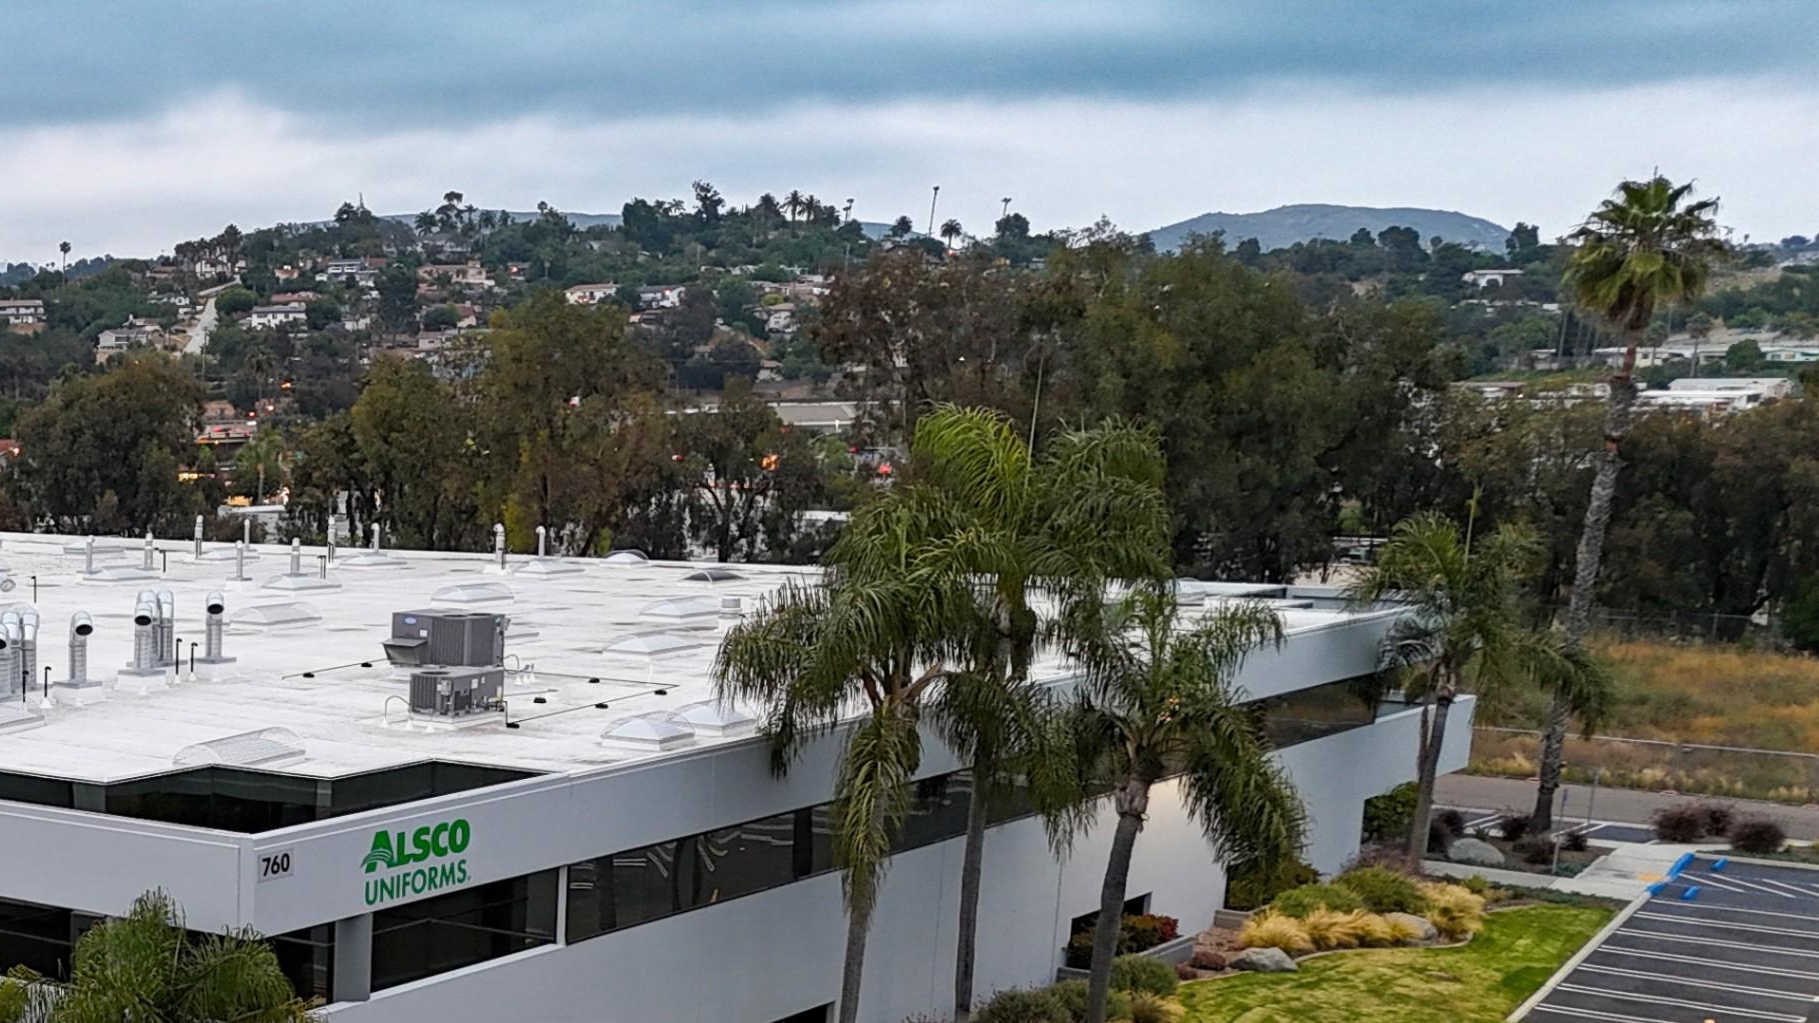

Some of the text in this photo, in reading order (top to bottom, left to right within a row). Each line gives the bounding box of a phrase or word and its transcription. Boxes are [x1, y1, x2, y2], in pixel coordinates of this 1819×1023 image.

[262, 853, 290, 876] 760
[360, 819, 471, 874] ALSCO
[365, 859, 468, 905] UNIFORMS
